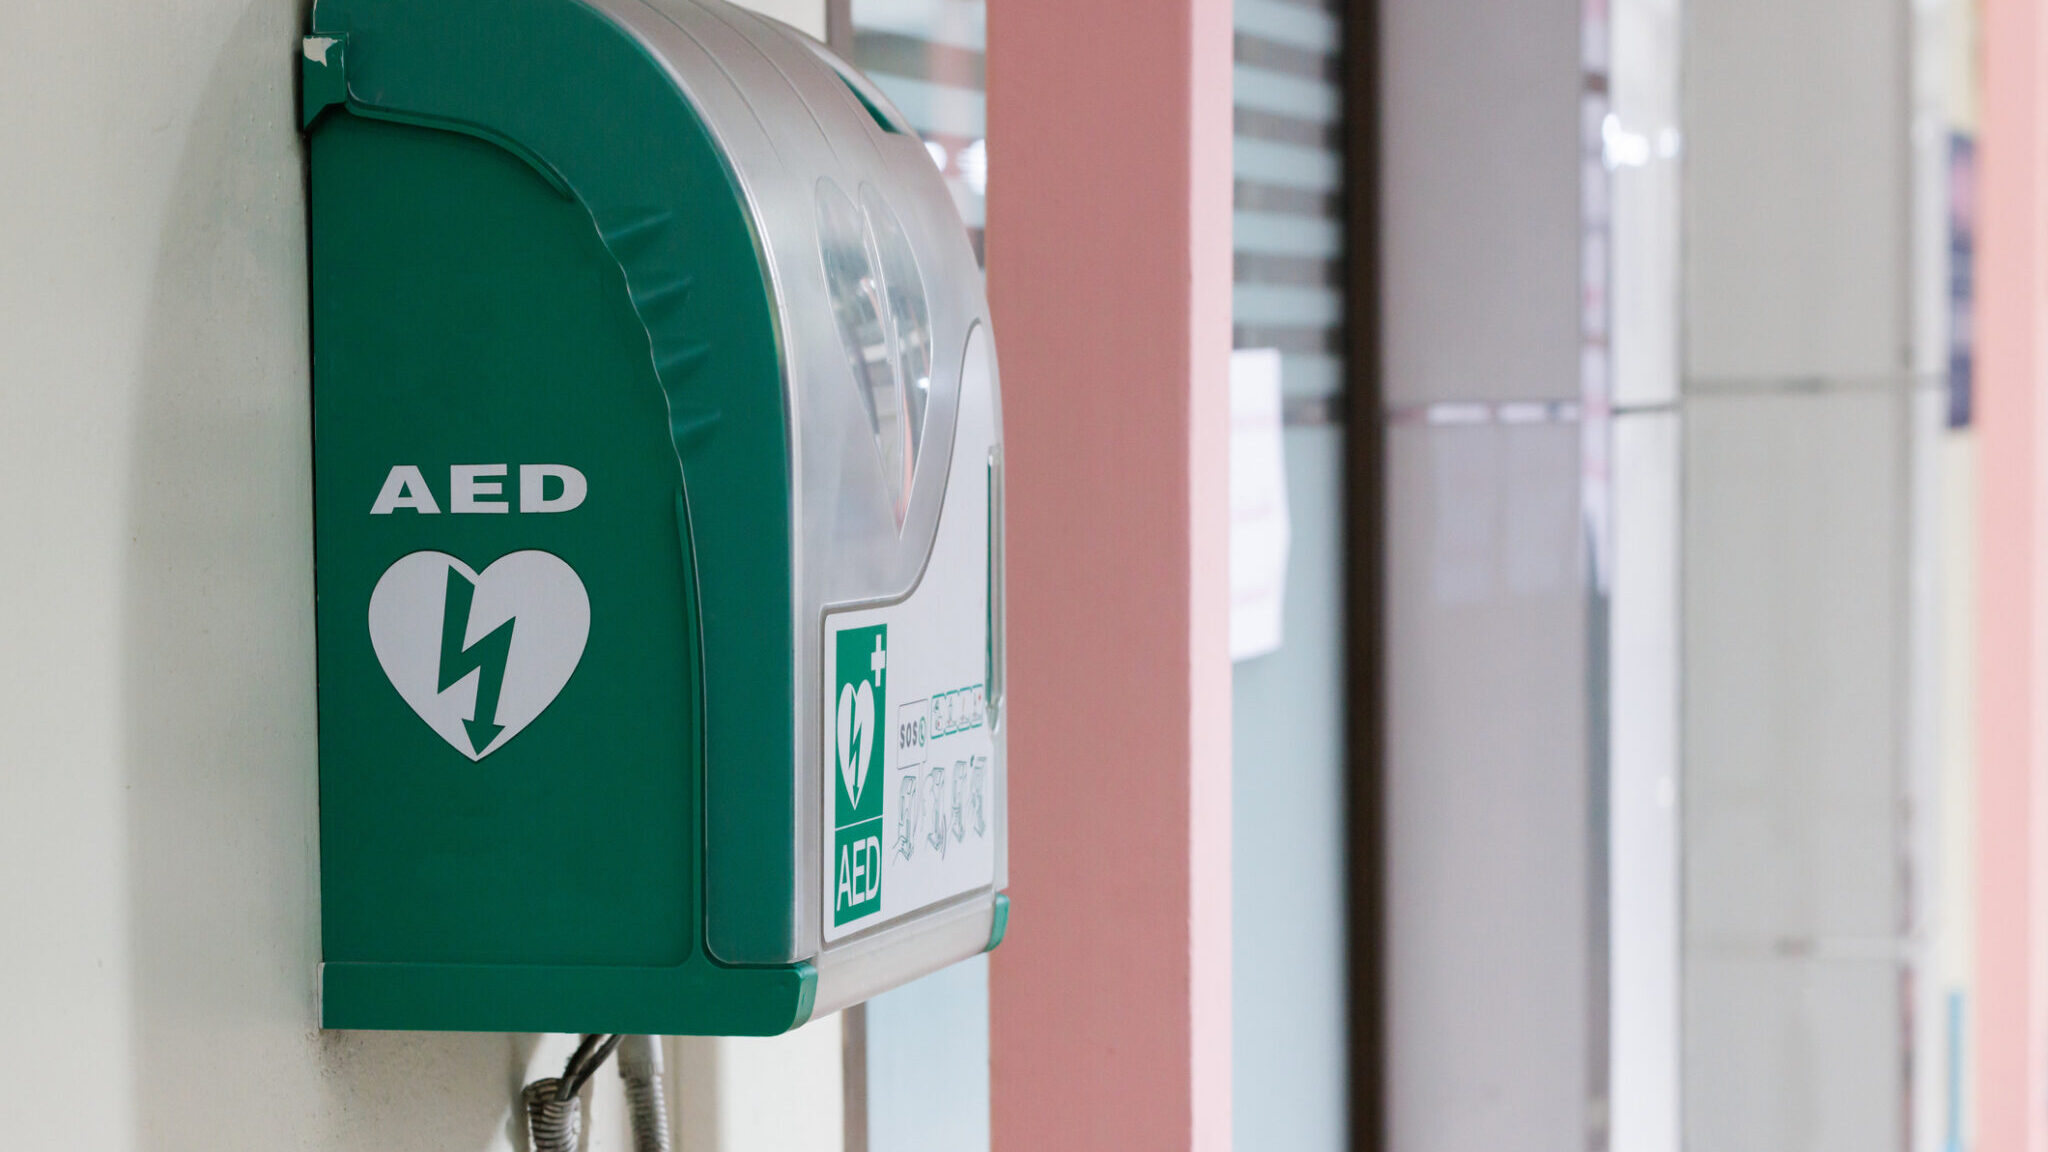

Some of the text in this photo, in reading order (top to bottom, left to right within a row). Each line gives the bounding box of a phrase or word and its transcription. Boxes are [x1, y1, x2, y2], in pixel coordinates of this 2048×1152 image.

[369, 463, 588, 514] AED
[900, 720, 918, 749] SOS
[836, 835, 881, 911] AED
